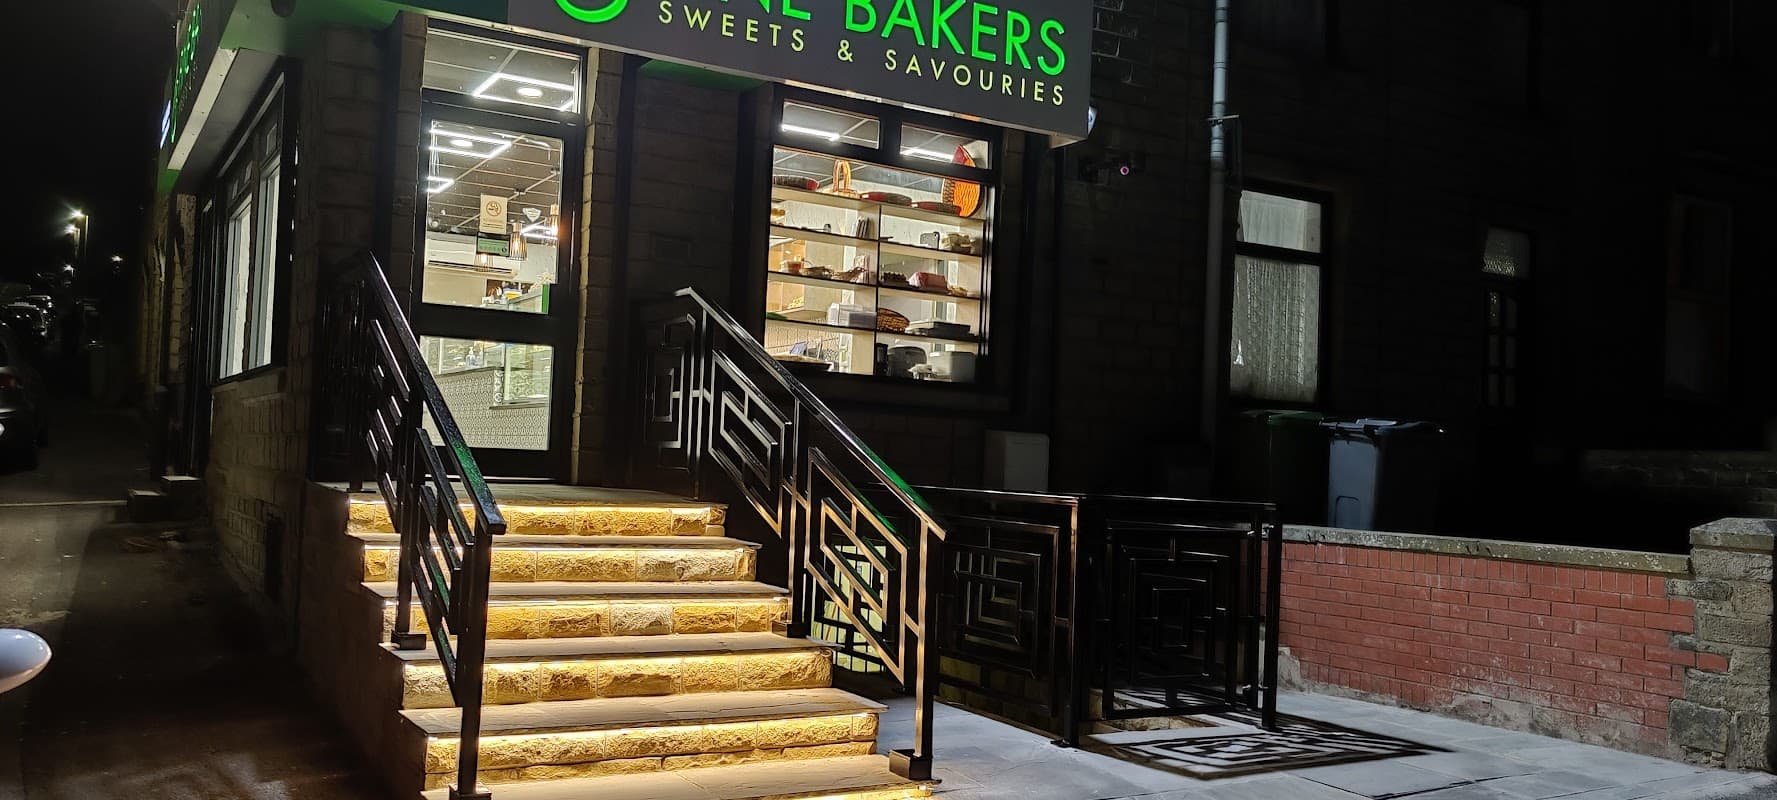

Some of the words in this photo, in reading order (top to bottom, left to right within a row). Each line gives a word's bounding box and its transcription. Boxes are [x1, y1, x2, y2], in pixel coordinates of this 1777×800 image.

[658, 0, 804, 52] SWEETS
[837, 39, 854, 63] &
[884, 49, 1064, 106] SAVOURIES
[845, 0, 1066, 76] BAKERS
